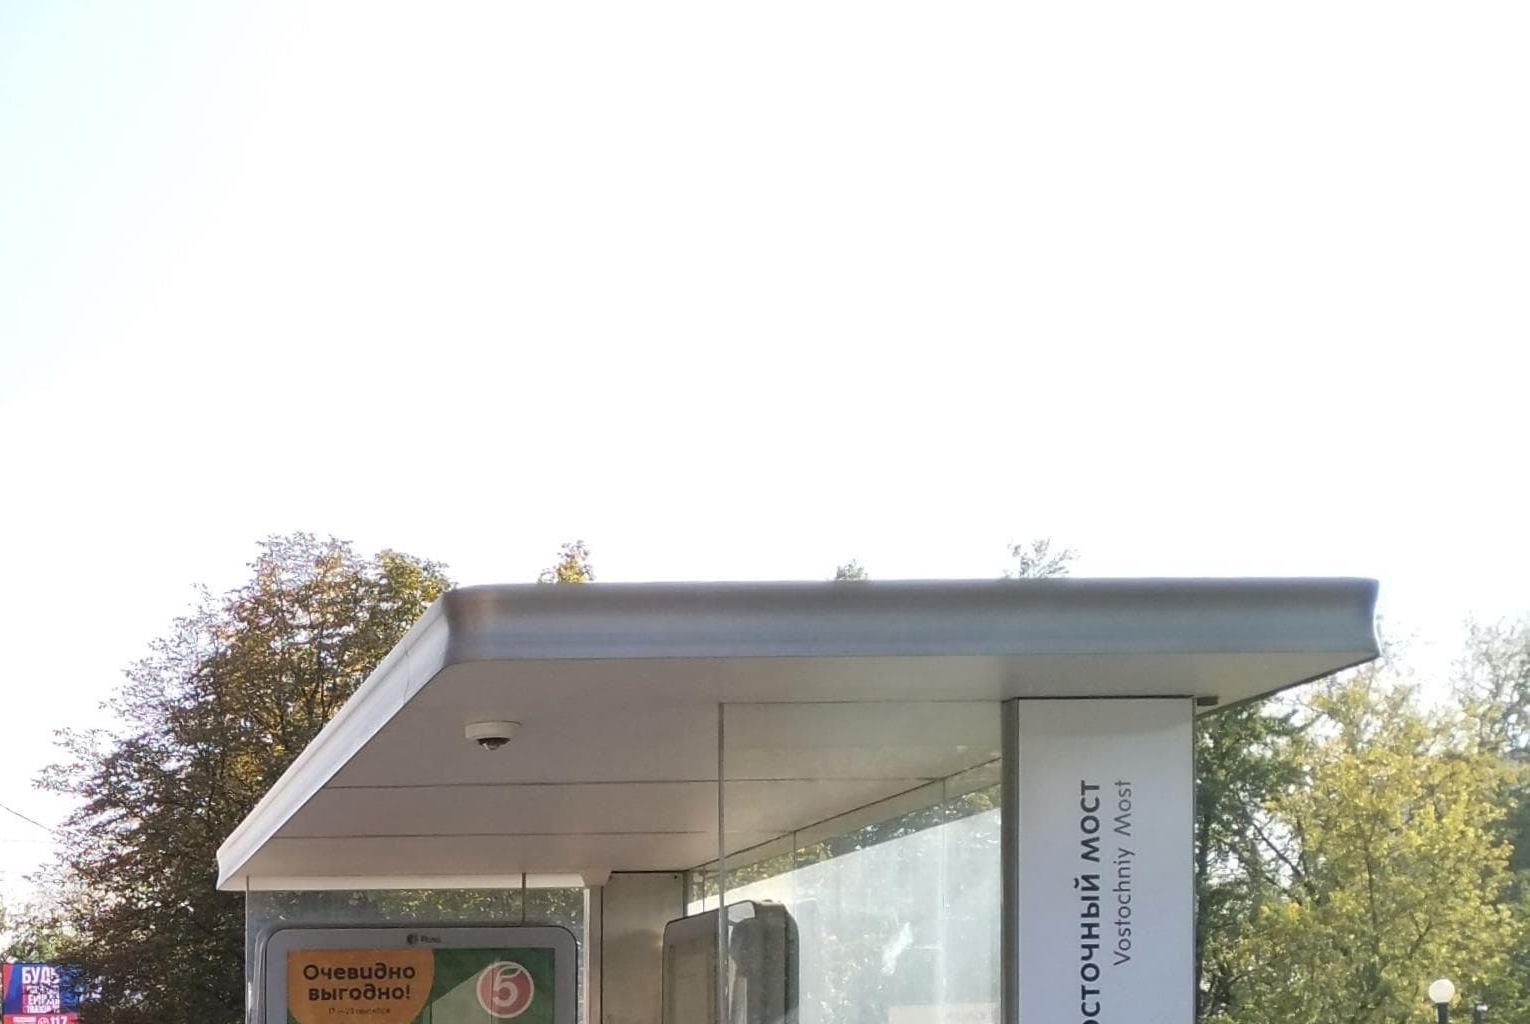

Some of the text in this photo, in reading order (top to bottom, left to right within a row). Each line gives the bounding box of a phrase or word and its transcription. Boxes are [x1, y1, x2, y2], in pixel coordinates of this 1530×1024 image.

[1080, 779, 1101, 863] мост
[1112, 779, 1135, 966] Vostochniy Most
[303, 962, 416, 981] Очевидно
[308, 984, 411, 1001] выгодно!
